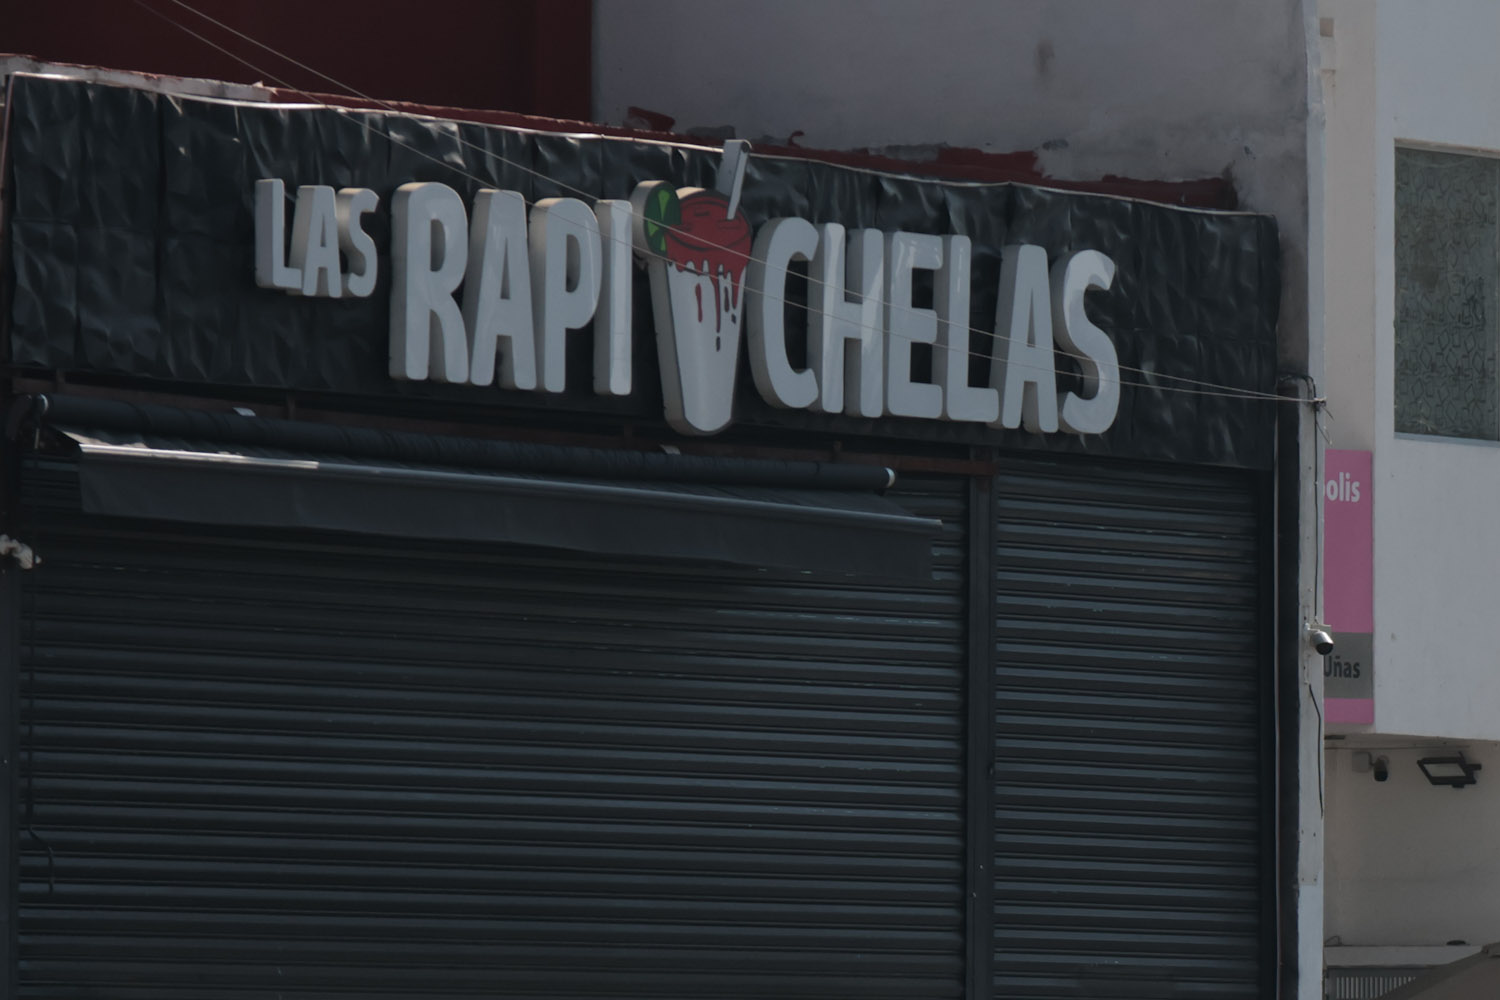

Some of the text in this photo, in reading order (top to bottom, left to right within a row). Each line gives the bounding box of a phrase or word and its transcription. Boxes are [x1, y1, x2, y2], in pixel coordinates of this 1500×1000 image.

[255, 178, 1120, 434] LAS RAPI CHELAS
[1324, 472, 1360, 502] olis
